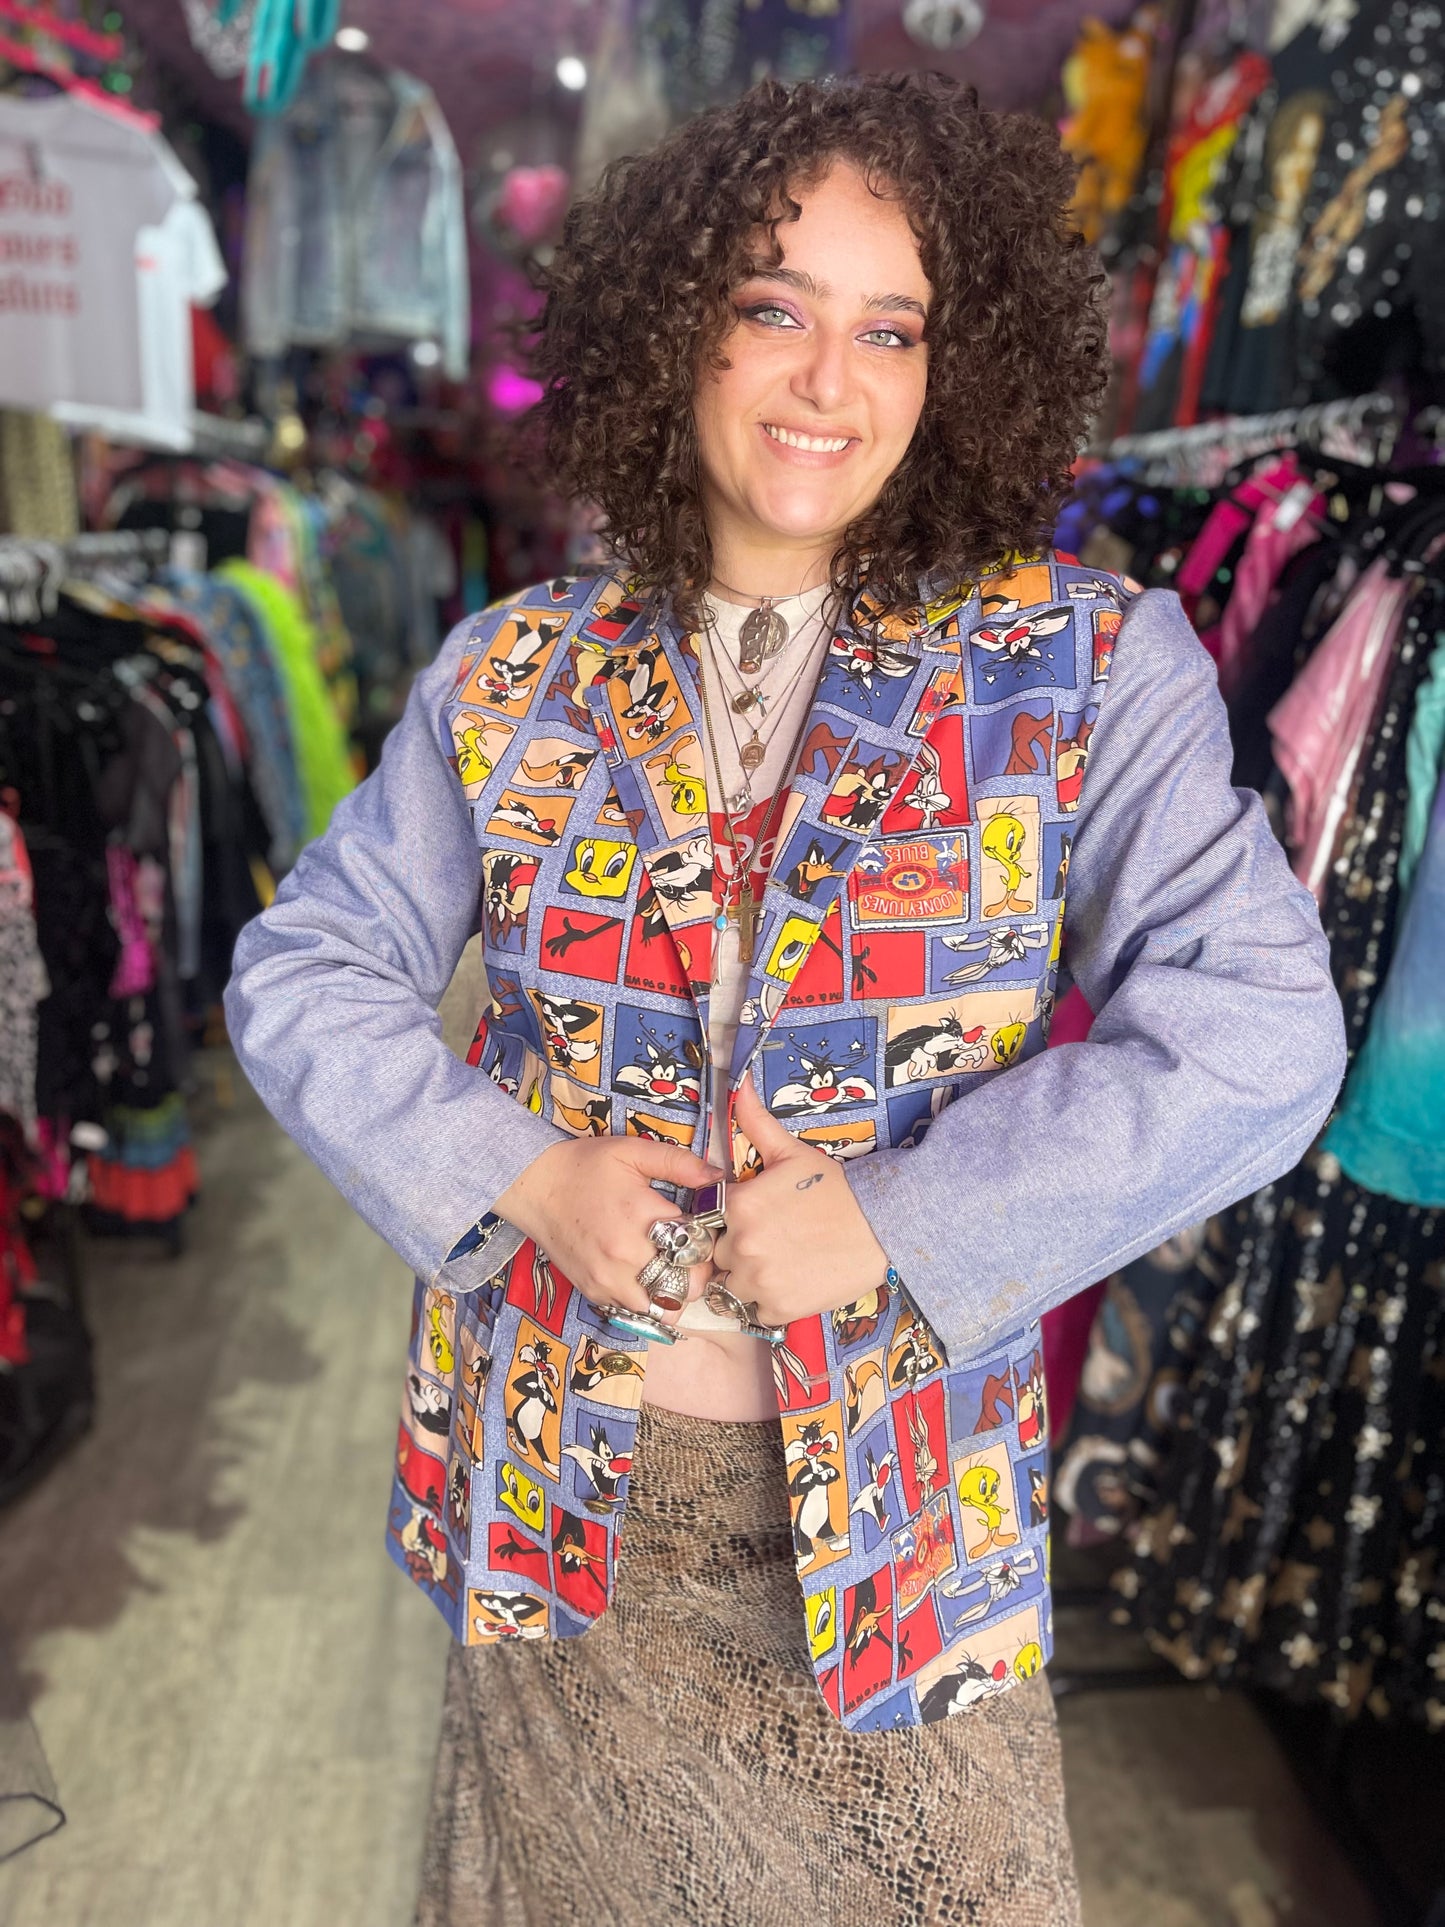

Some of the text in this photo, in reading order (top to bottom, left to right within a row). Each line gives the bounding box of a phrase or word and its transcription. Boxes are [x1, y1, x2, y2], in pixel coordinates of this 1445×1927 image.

[884, 843, 929, 863] BLUES
[863, 888, 958, 917] LOONEY TUNES
